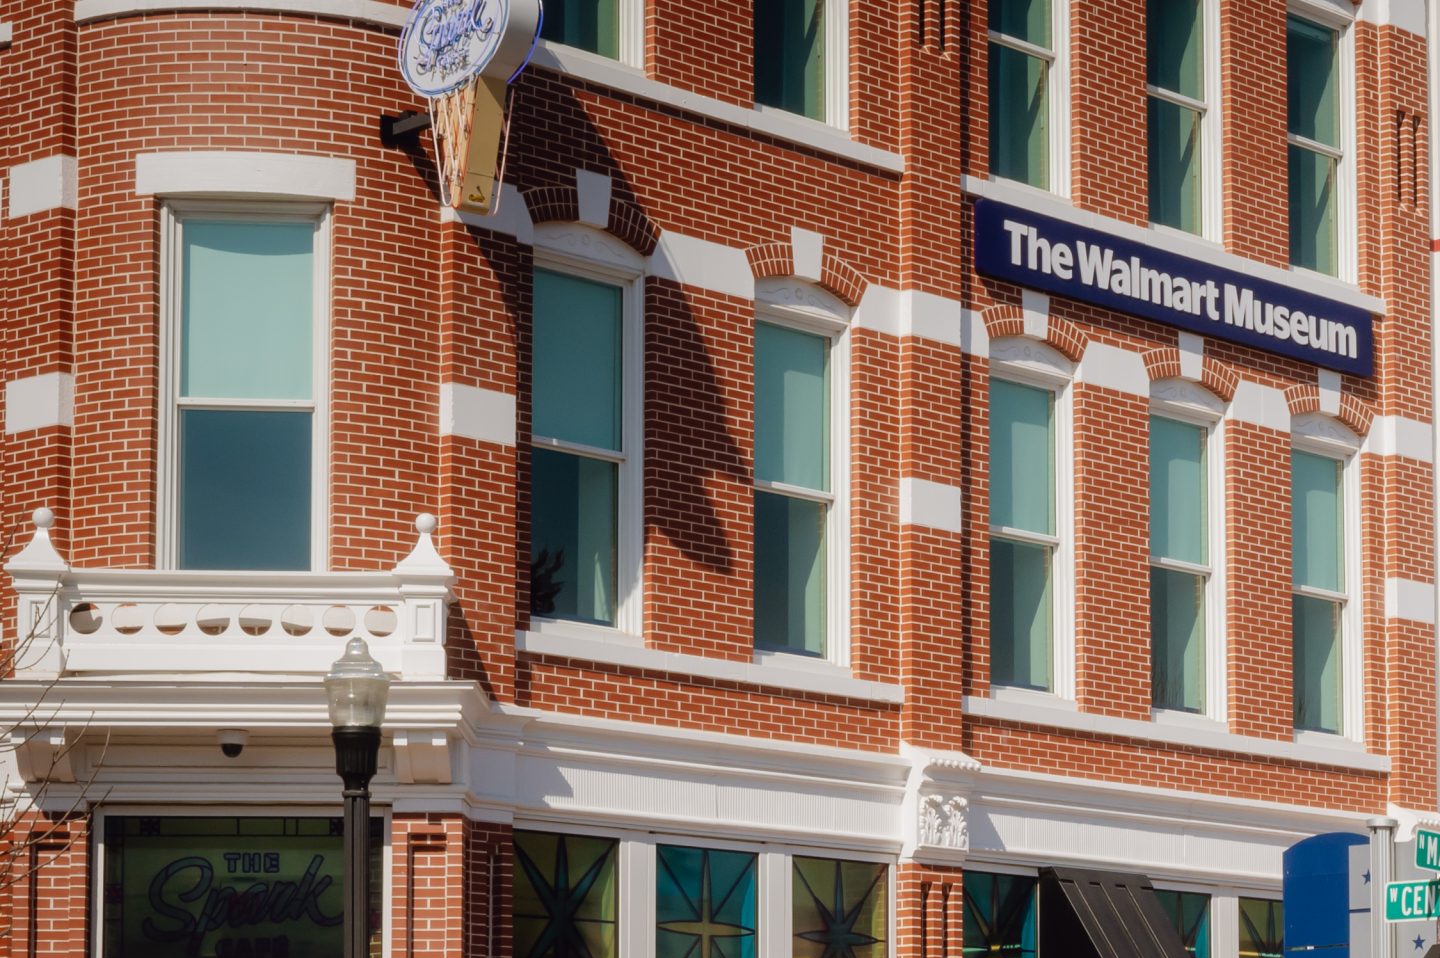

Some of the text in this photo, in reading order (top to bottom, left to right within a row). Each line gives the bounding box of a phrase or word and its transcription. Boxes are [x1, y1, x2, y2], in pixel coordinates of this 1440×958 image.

[1003, 219, 1358, 359] The Walmart Museum
[1419, 834, 1425, 850] N
[223, 853, 280, 873] THE
[1389, 888, 1398, 903] W
[142, 855, 344, 958] Spark
